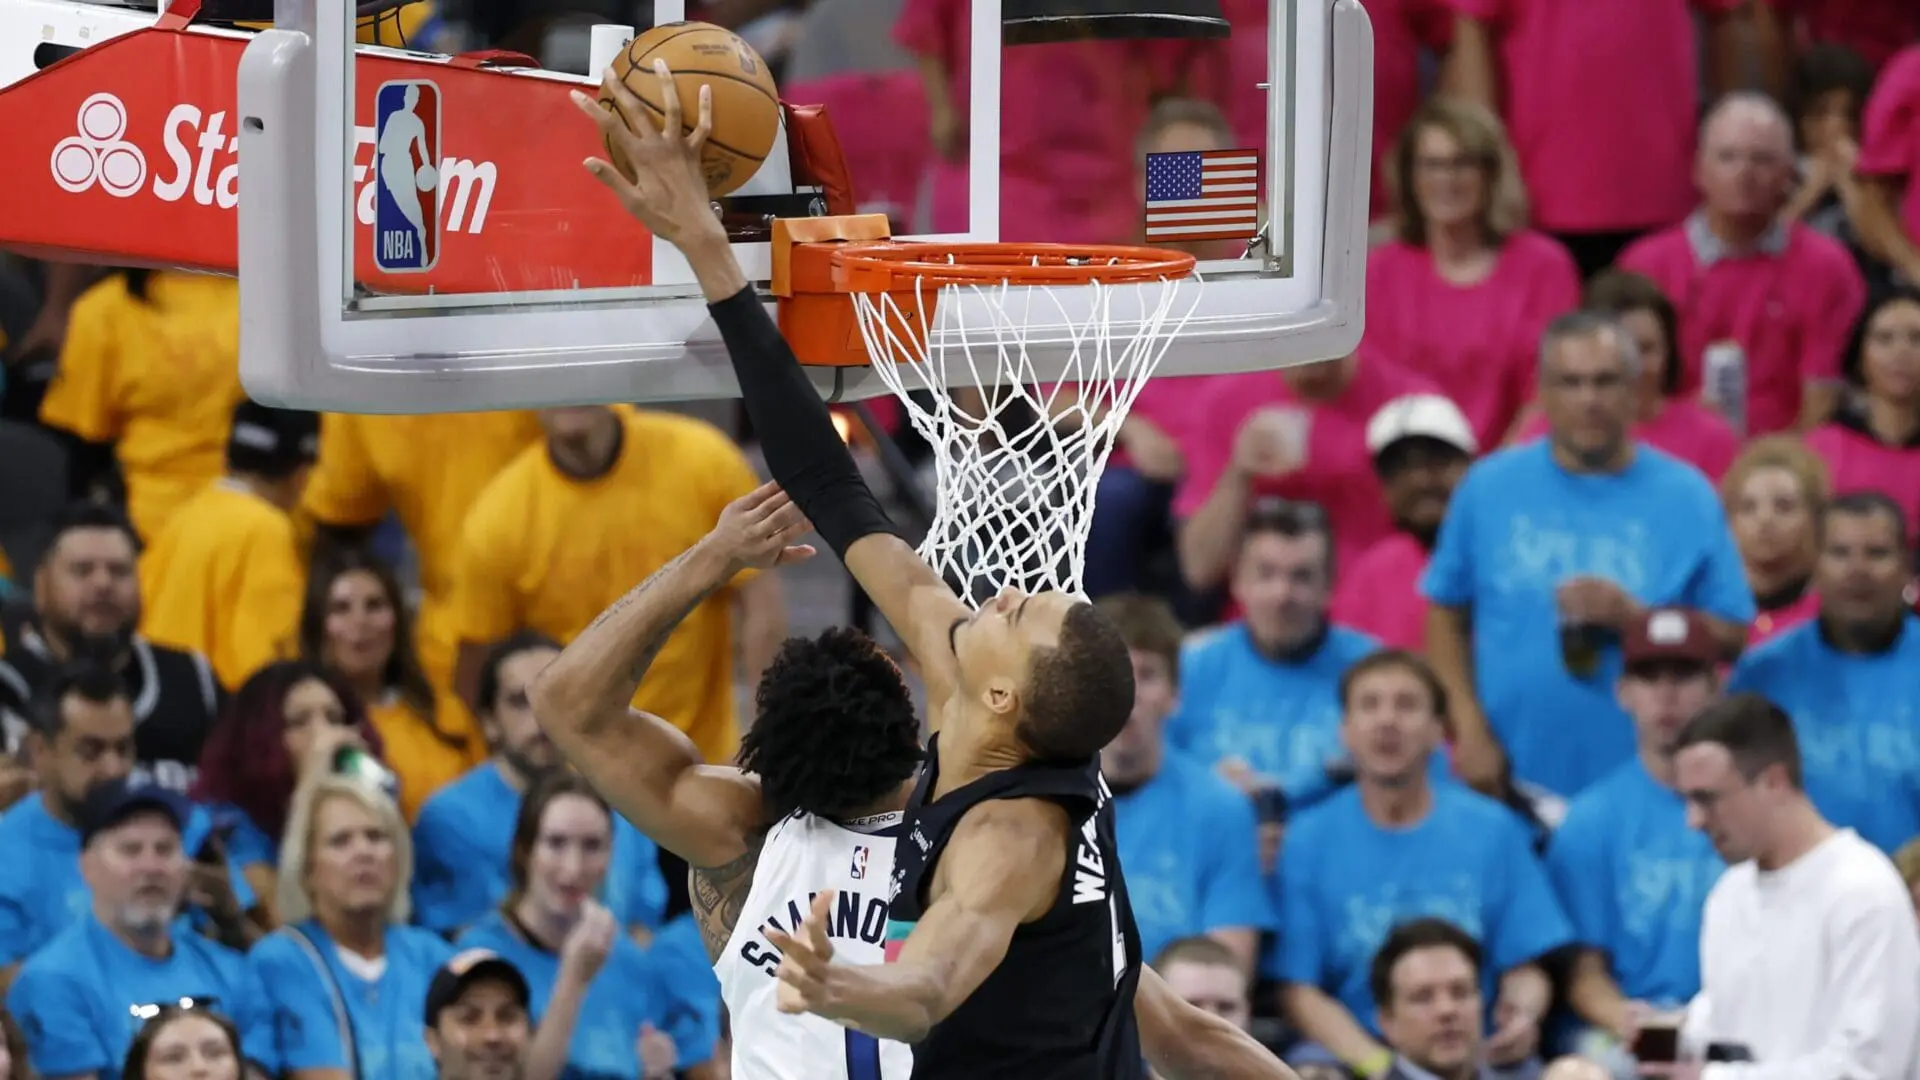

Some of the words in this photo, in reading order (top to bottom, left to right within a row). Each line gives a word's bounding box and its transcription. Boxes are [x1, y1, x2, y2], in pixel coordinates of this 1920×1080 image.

[153, 103, 239, 209] Sta
[353, 125, 498, 234] Fam
[383, 230, 414, 260] NBA
[868, 812, 897, 825] PRO
